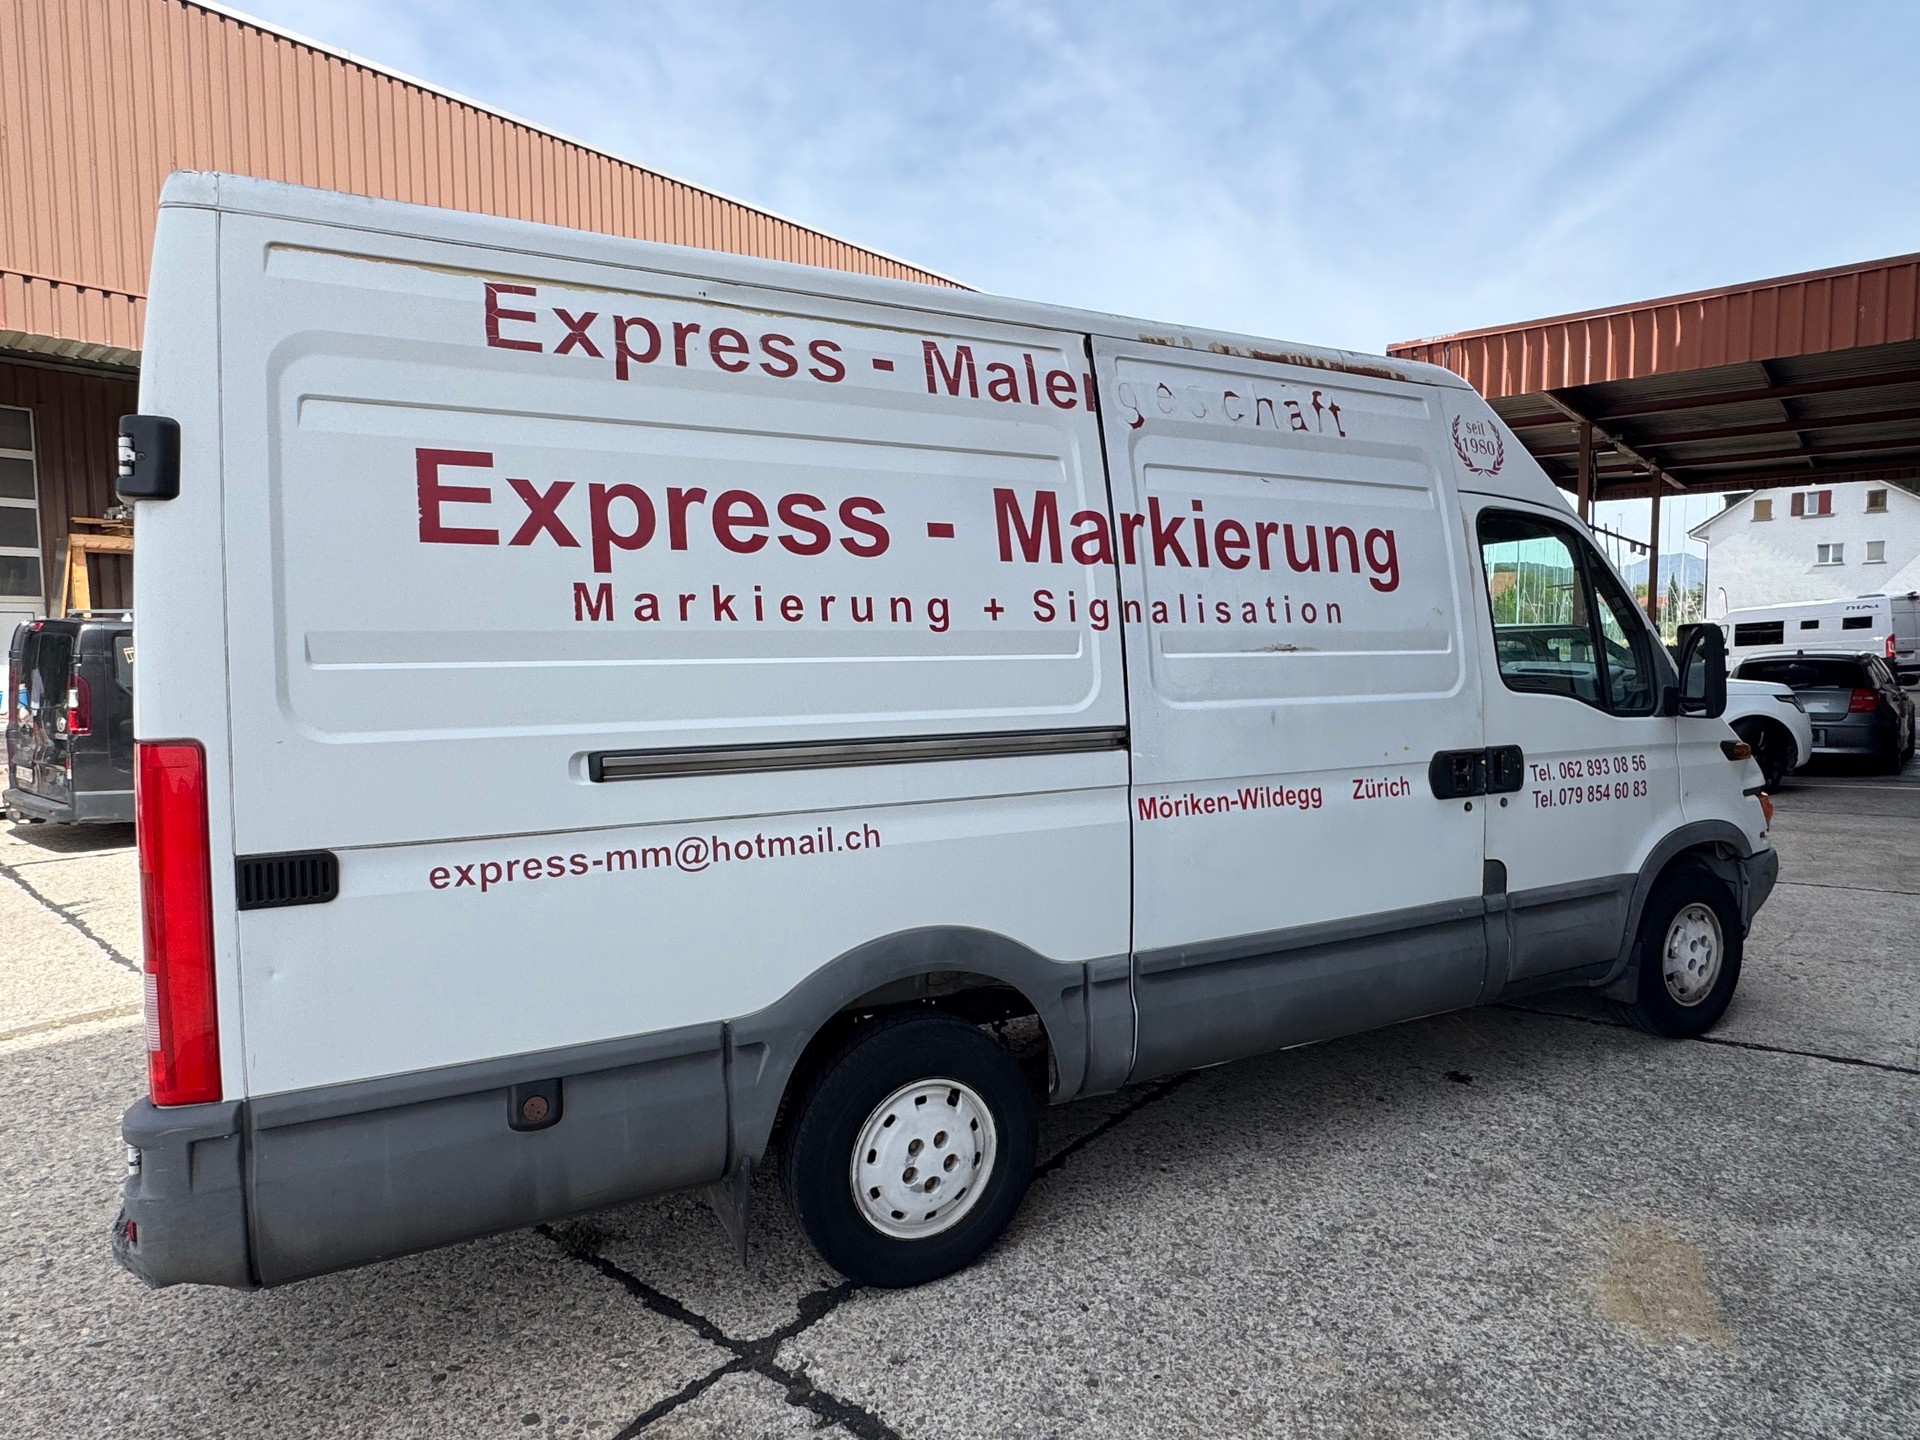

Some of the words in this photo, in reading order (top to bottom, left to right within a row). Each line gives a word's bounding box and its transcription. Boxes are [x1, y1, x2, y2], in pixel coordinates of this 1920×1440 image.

[484, 282, 846, 383] Express
[872, 358, 895, 372] -
[1462, 437, 1495, 456] 1980
[415, 447, 891, 574] Express
[926, 522, 955, 539] -
[993, 487, 1400, 593] Markierung
[573, 581, 950, 633] Markierung
[984, 598, 1005, 621] +
[1033, 589, 1343, 631] Signalisation
[1530, 763, 1556, 782] Tel.
[1559, 760, 1584, 779] 062
[1586, 758, 1610, 777] 893
[1613, 756, 1629, 773] 08
[1632, 754, 1647, 772] 56
[1138, 785, 1323, 821] Möriken-Wildegg
[1352, 776, 1411, 800] Zürich
[1532, 790, 1557, 808] Tel.
[1559, 786, 1583, 805] 079
[1587, 783, 1611, 802] 854
[1614, 782, 1629, 799] 60
[1632, 780, 1647, 797] 83
[429, 823, 882, 893] express-mm@hotmail.ch
